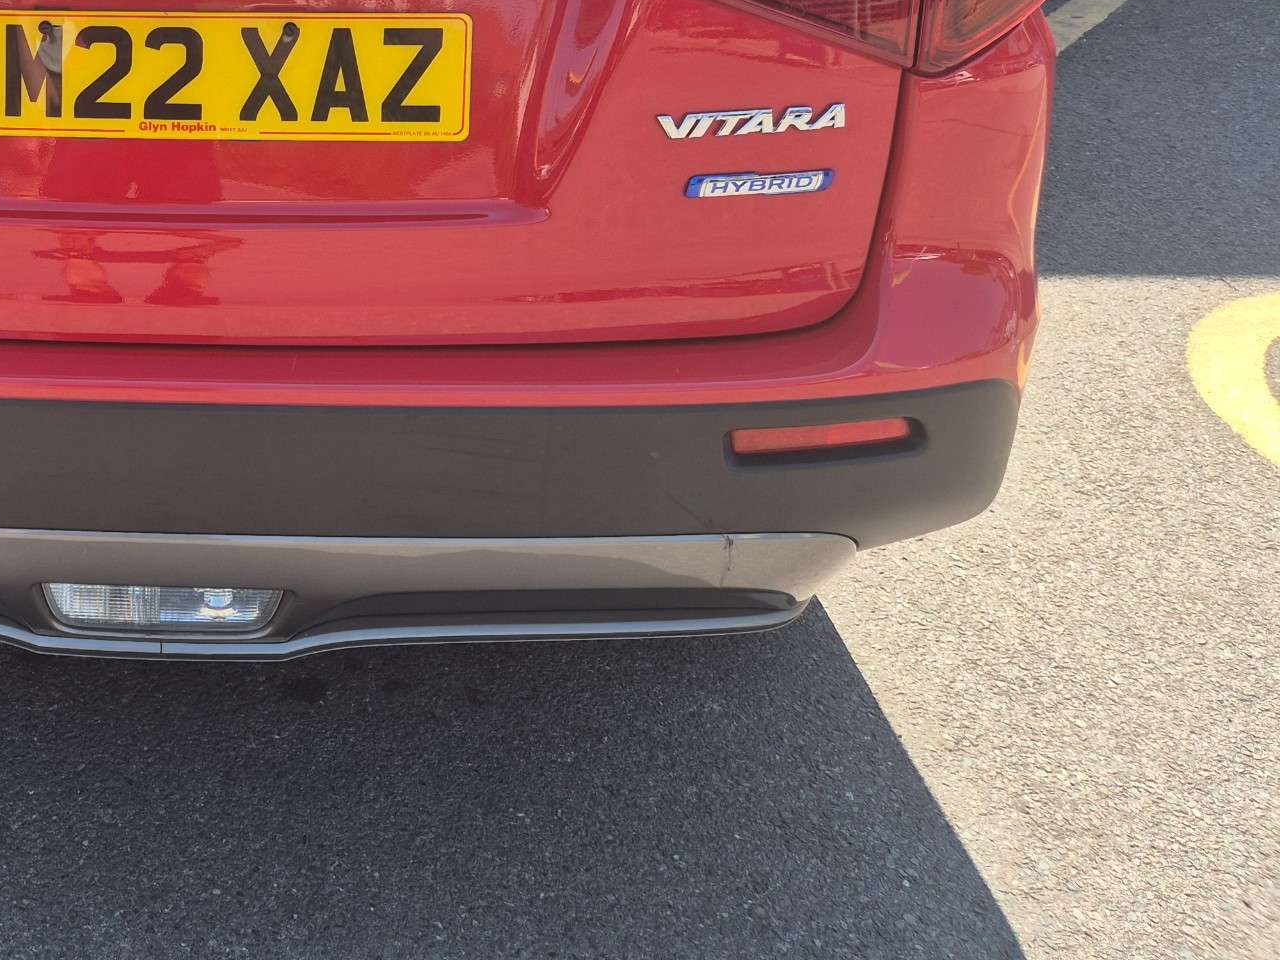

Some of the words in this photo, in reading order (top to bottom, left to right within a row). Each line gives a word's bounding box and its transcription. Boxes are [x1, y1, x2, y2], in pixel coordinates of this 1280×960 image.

[239, 27, 444, 123] XAZ
[138, 121, 168, 133] Glyn
[171, 122, 217, 134] Hopkin
[656, 103, 846, 140] VITARA
[710, 176, 814, 194] HYBRID
